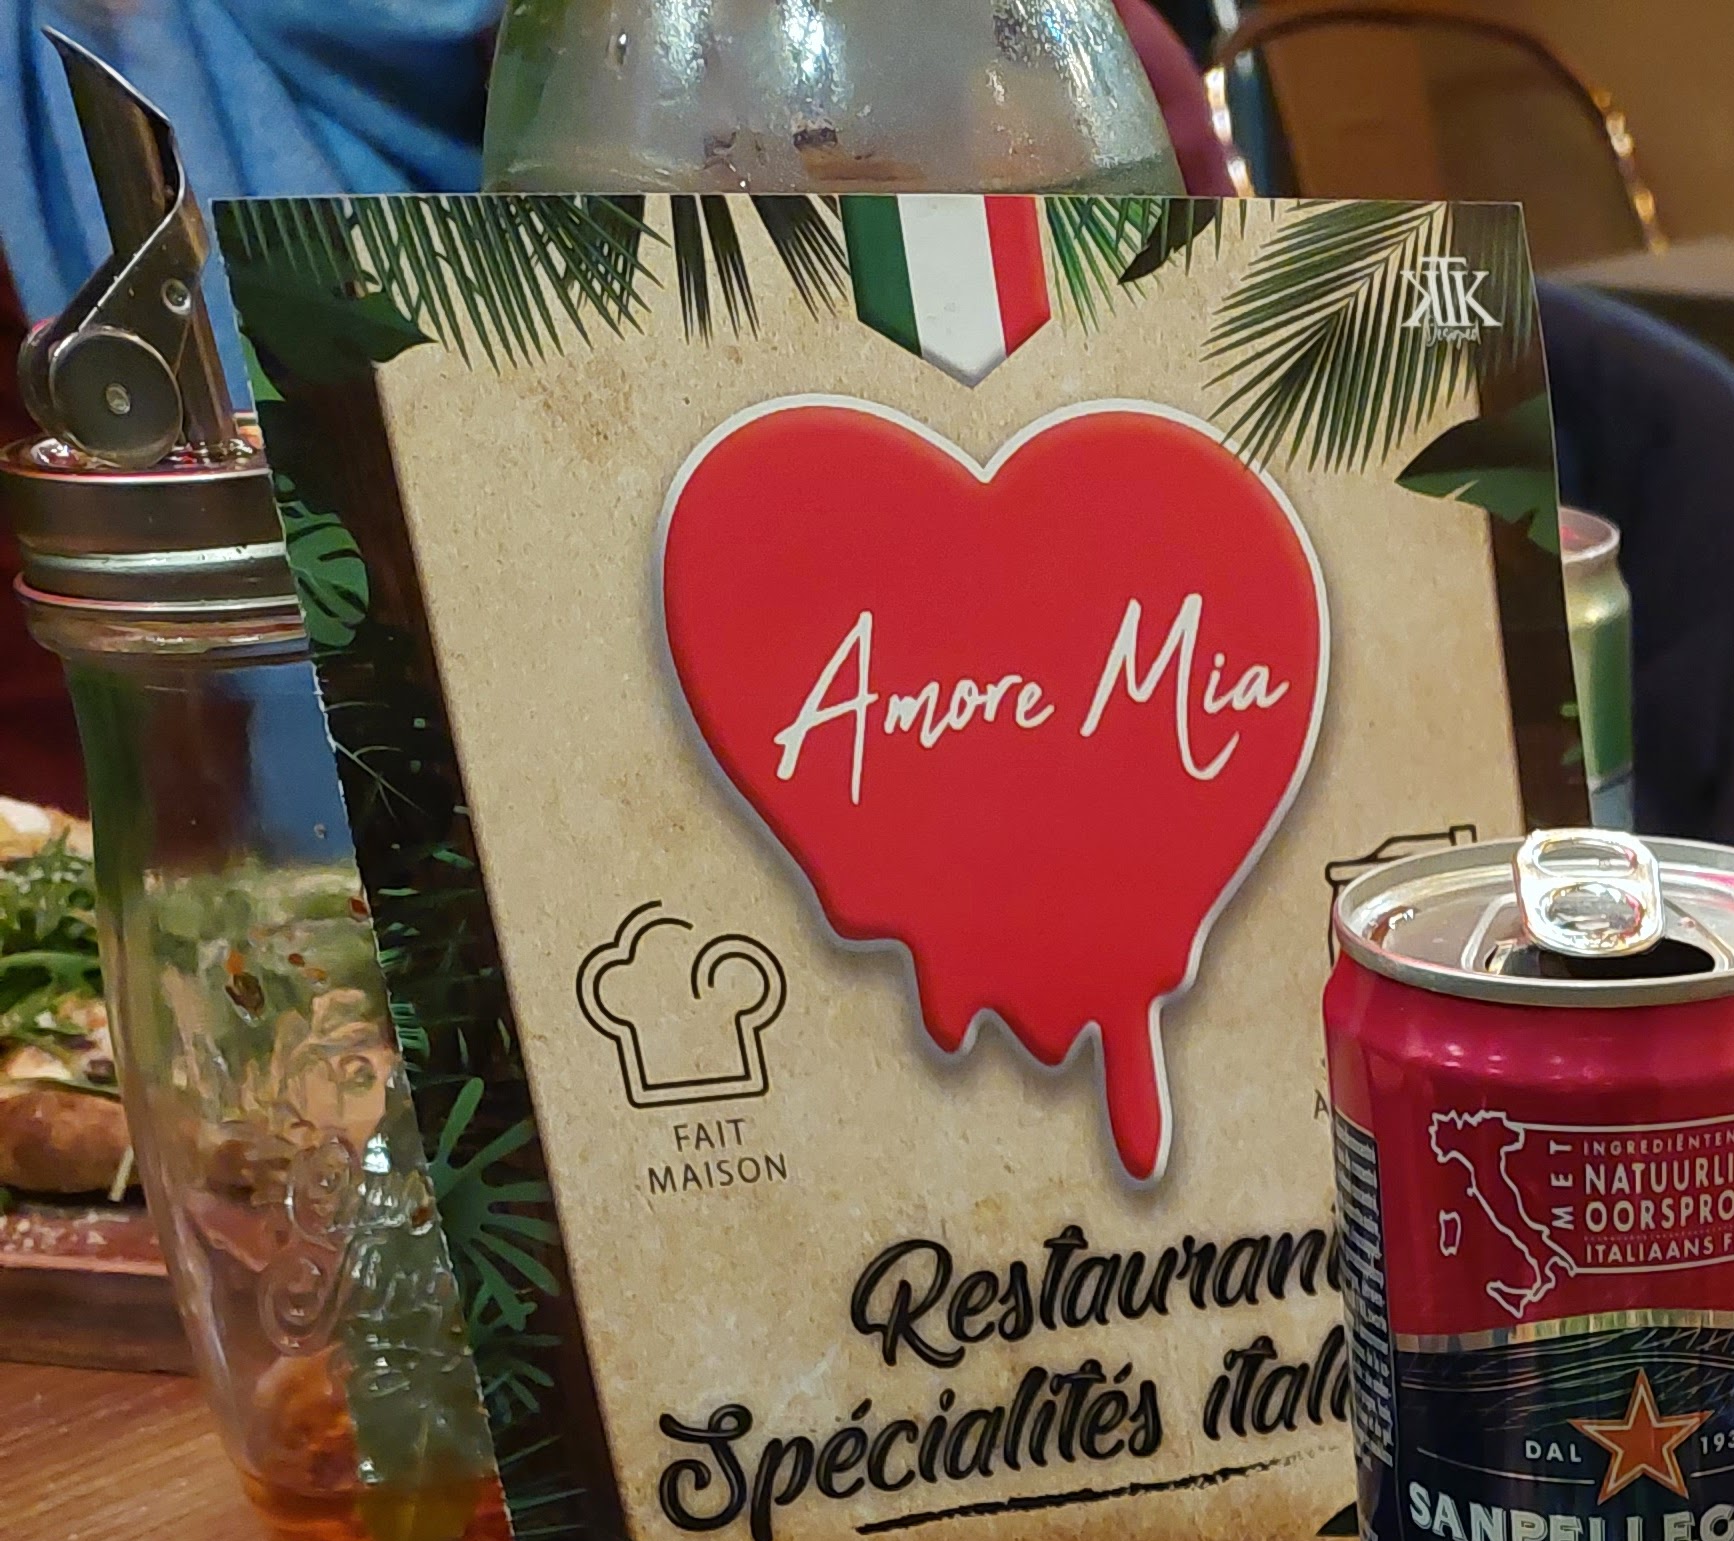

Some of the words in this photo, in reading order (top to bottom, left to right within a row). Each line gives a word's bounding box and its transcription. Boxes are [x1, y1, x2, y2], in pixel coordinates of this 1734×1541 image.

[774, 610, 1054, 805] Amore
[1080, 592, 1289, 780] Mia
[672, 1117, 748, 1153] FAIT
[647, 1153, 788, 1195] MAISON
[1586, 1236, 1714, 1265] ITALIAANS
[1525, 1439, 1582, 1463] DAL
